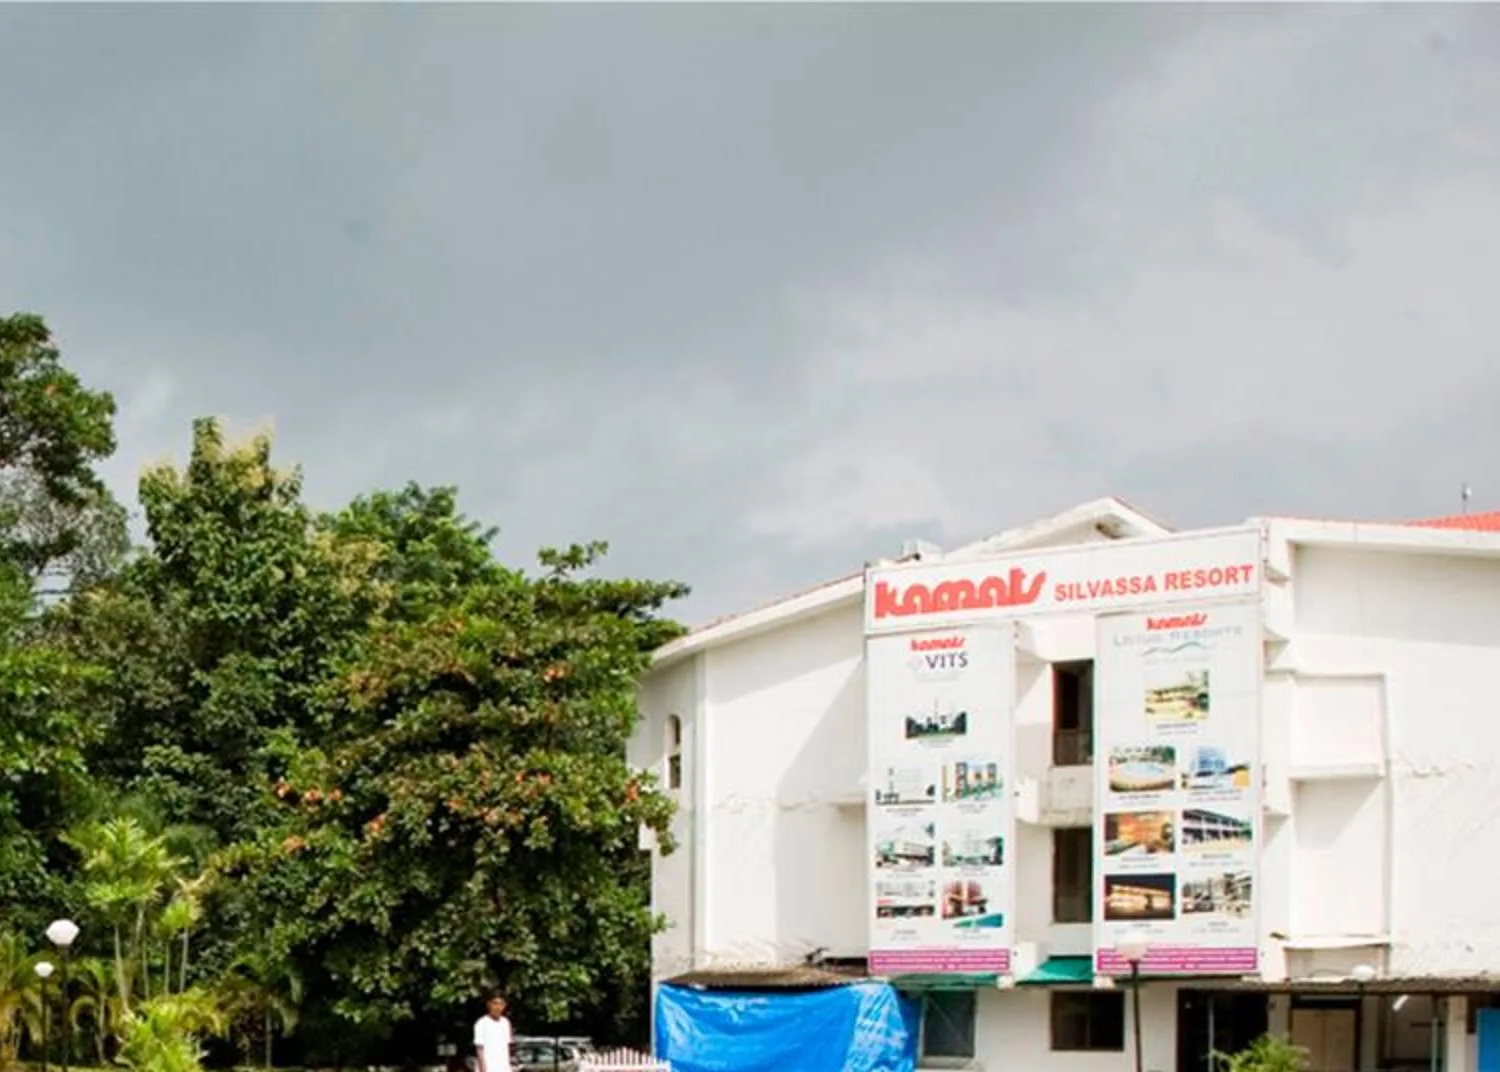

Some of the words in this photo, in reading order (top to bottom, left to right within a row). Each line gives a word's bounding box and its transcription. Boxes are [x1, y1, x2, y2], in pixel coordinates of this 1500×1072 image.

[1054, 576, 1157, 603] SILVASSA
[1164, 564, 1254, 590] RESORT
[924, 650, 969, 670] VITS
